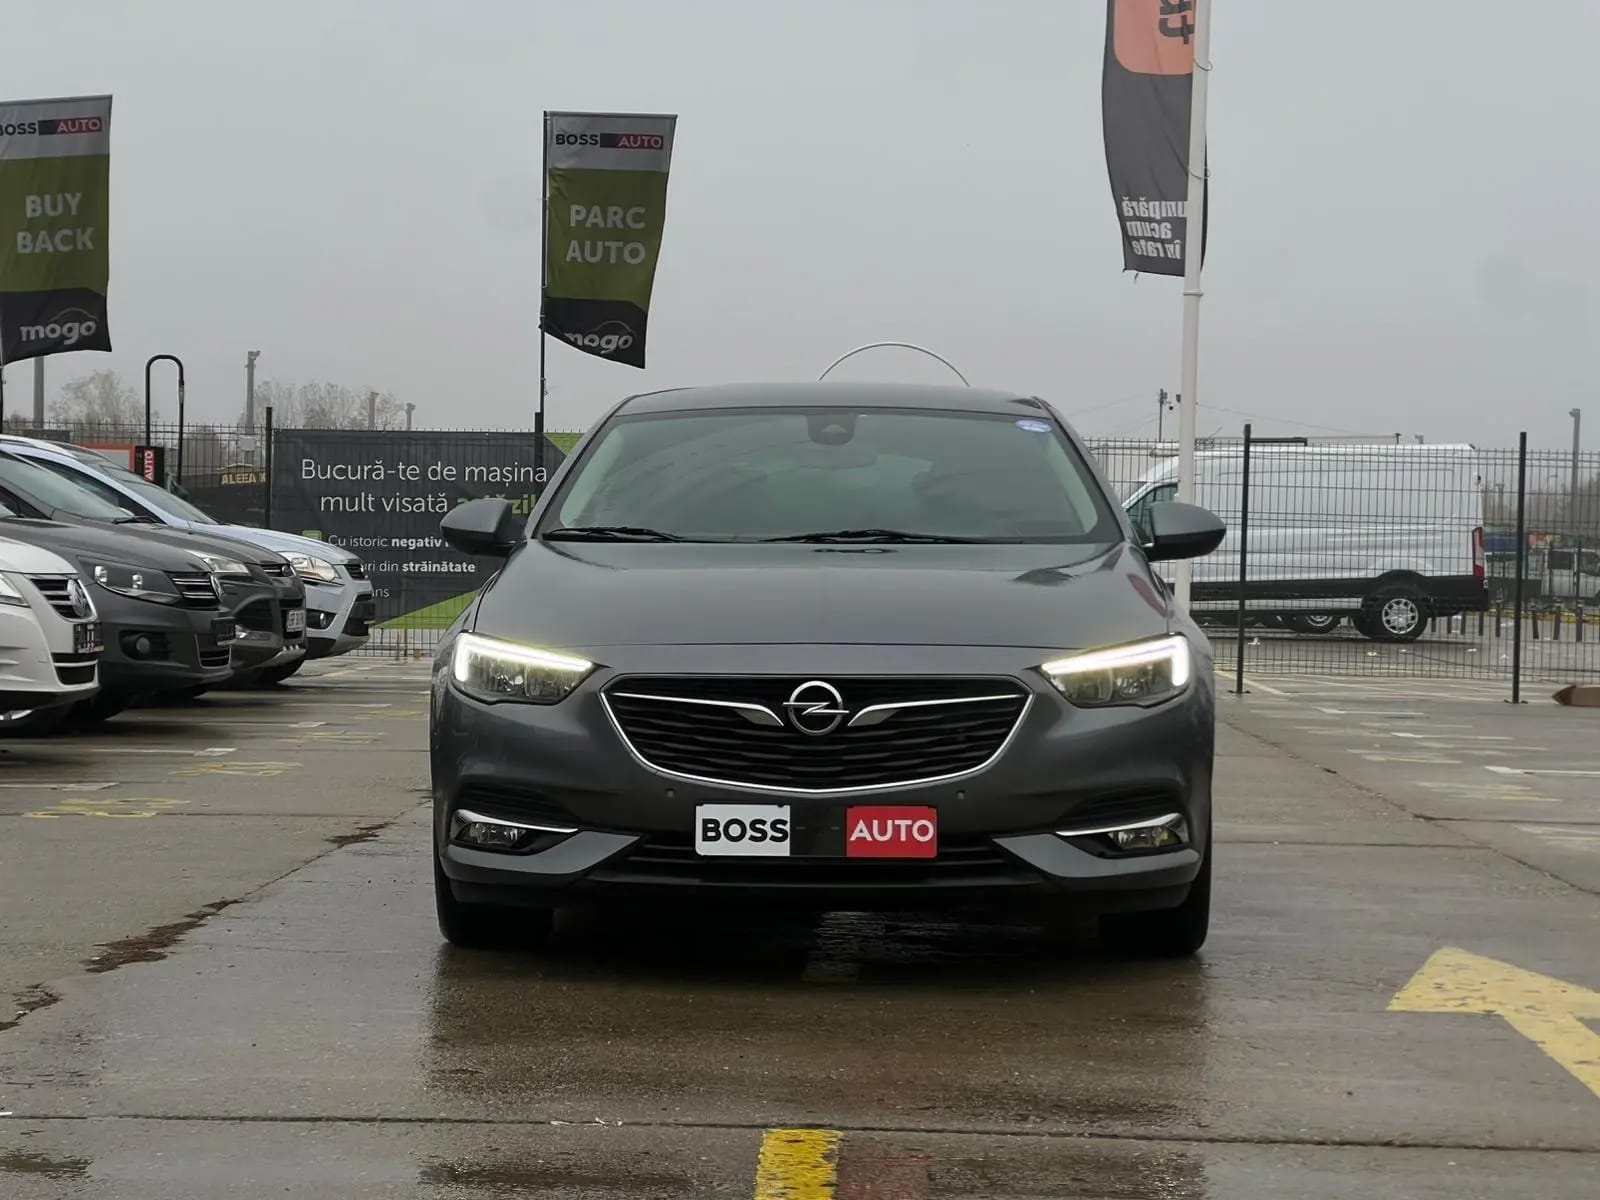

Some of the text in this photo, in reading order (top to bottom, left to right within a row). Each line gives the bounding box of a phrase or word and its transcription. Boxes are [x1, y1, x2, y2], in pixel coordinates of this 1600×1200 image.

[57, 118, 101, 133] AUTO
[555, 133, 662, 148] BOSS AUTO
[25, 192, 82, 218] BUY
[569, 204, 646, 229] PARC
[17, 227, 95, 255] BACK
[565, 240, 646, 265] AUTO
[19, 320, 97, 346] mogo
[144, 450, 154, 480] AUTO
[301, 458, 547, 487] Bucură-te de mașina
[320, 492, 375, 512] mult
[382, 492, 449, 513] visată
[328, 534, 346, 547] Cu
[350, 535, 388, 547] istoric
[391, 535, 443, 550] negativ
[379, 560, 399, 572] din
[402, 560, 476, 572] străinătate
[701, 818, 934, 842] BOSS AUTO
